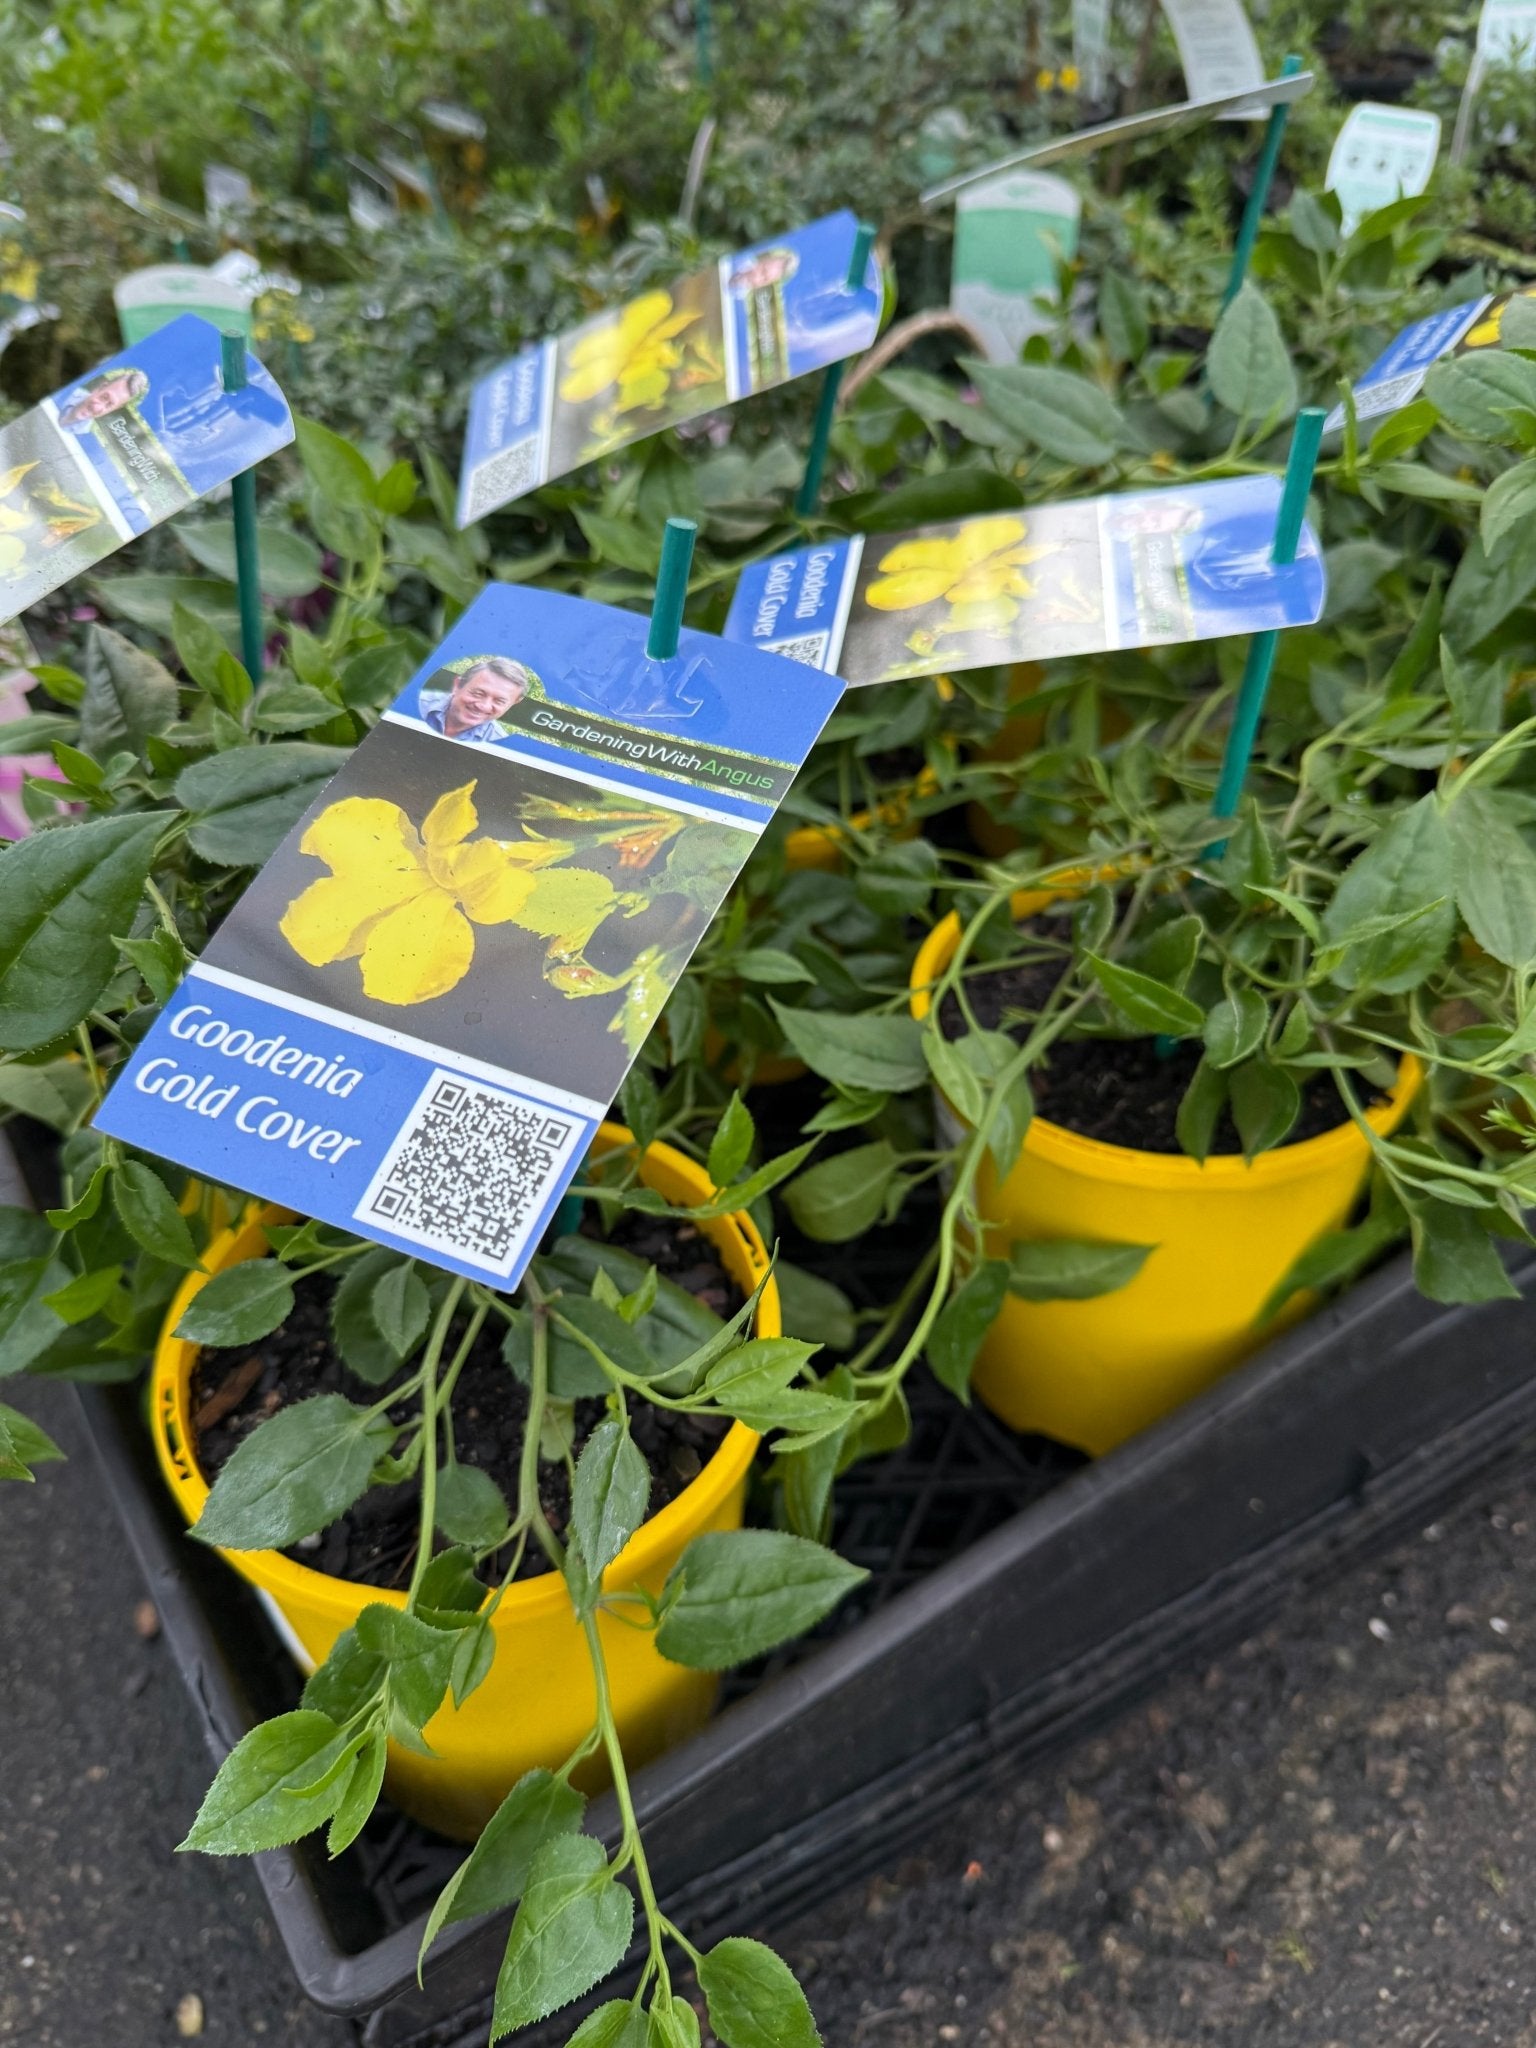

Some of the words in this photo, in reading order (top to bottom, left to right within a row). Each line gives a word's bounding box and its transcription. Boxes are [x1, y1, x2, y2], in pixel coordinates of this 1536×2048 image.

[764, 561, 797, 597] Gold
[795, 552, 835, 619] Goodenia
[752, 596, 788, 637] Cover
[531, 711, 775, 789] GardeningWithAngus
[169, 1005, 364, 1098] Goodenia
[136, 1058, 240, 1119] Gold
[236, 1096, 361, 1165] Cover
